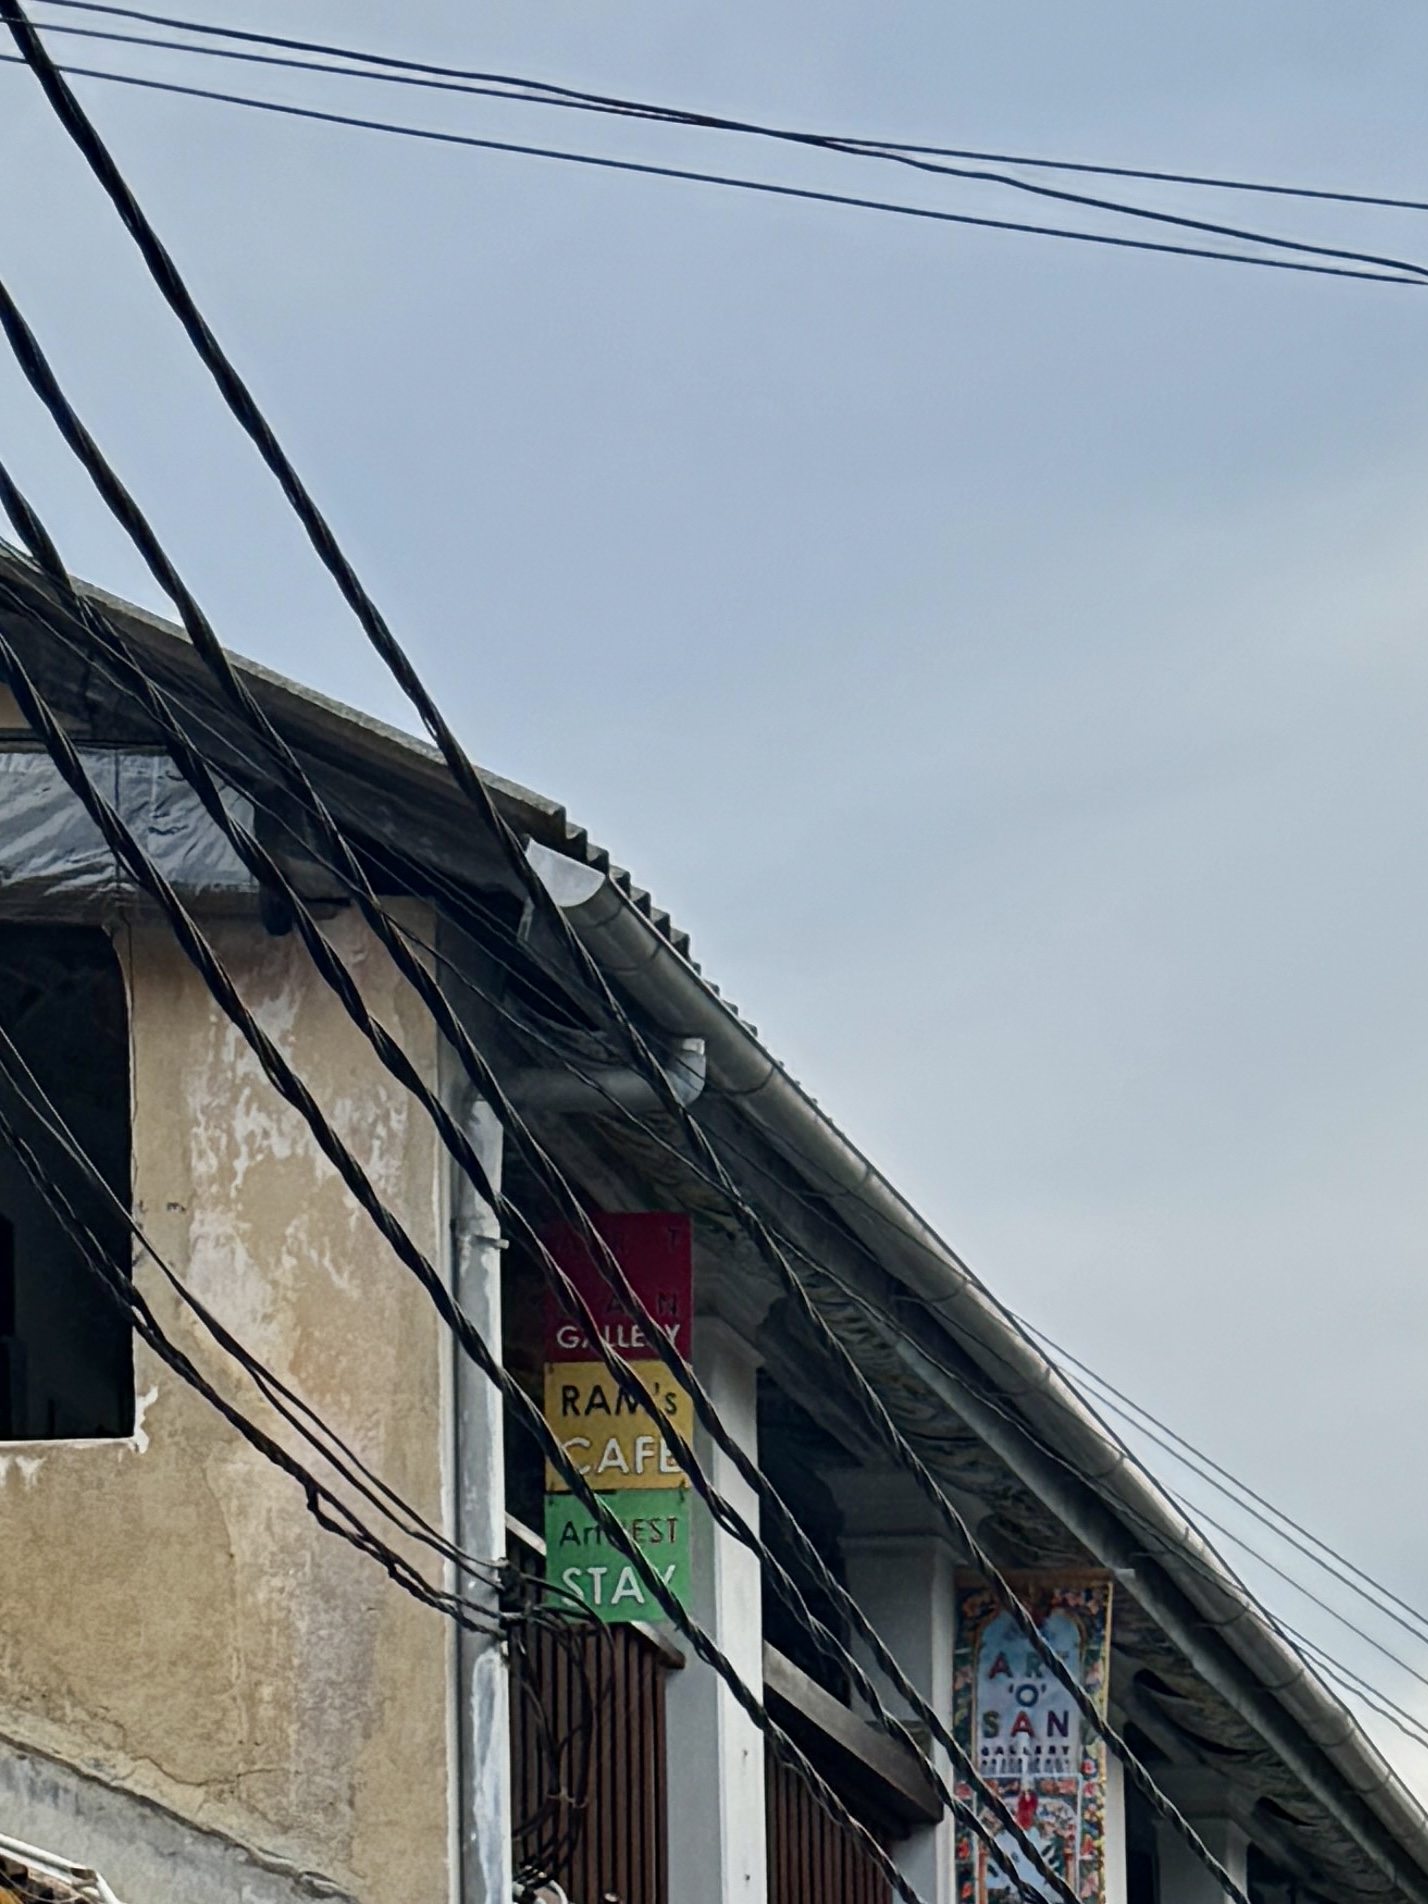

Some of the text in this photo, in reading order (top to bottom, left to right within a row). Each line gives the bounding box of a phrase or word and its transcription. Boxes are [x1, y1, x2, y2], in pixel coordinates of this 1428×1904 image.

[556, 1323, 681, 1349] GLLEY
[987, 1650, 1069, 1679] AR
[981, 1709, 1070, 1738] SAN
